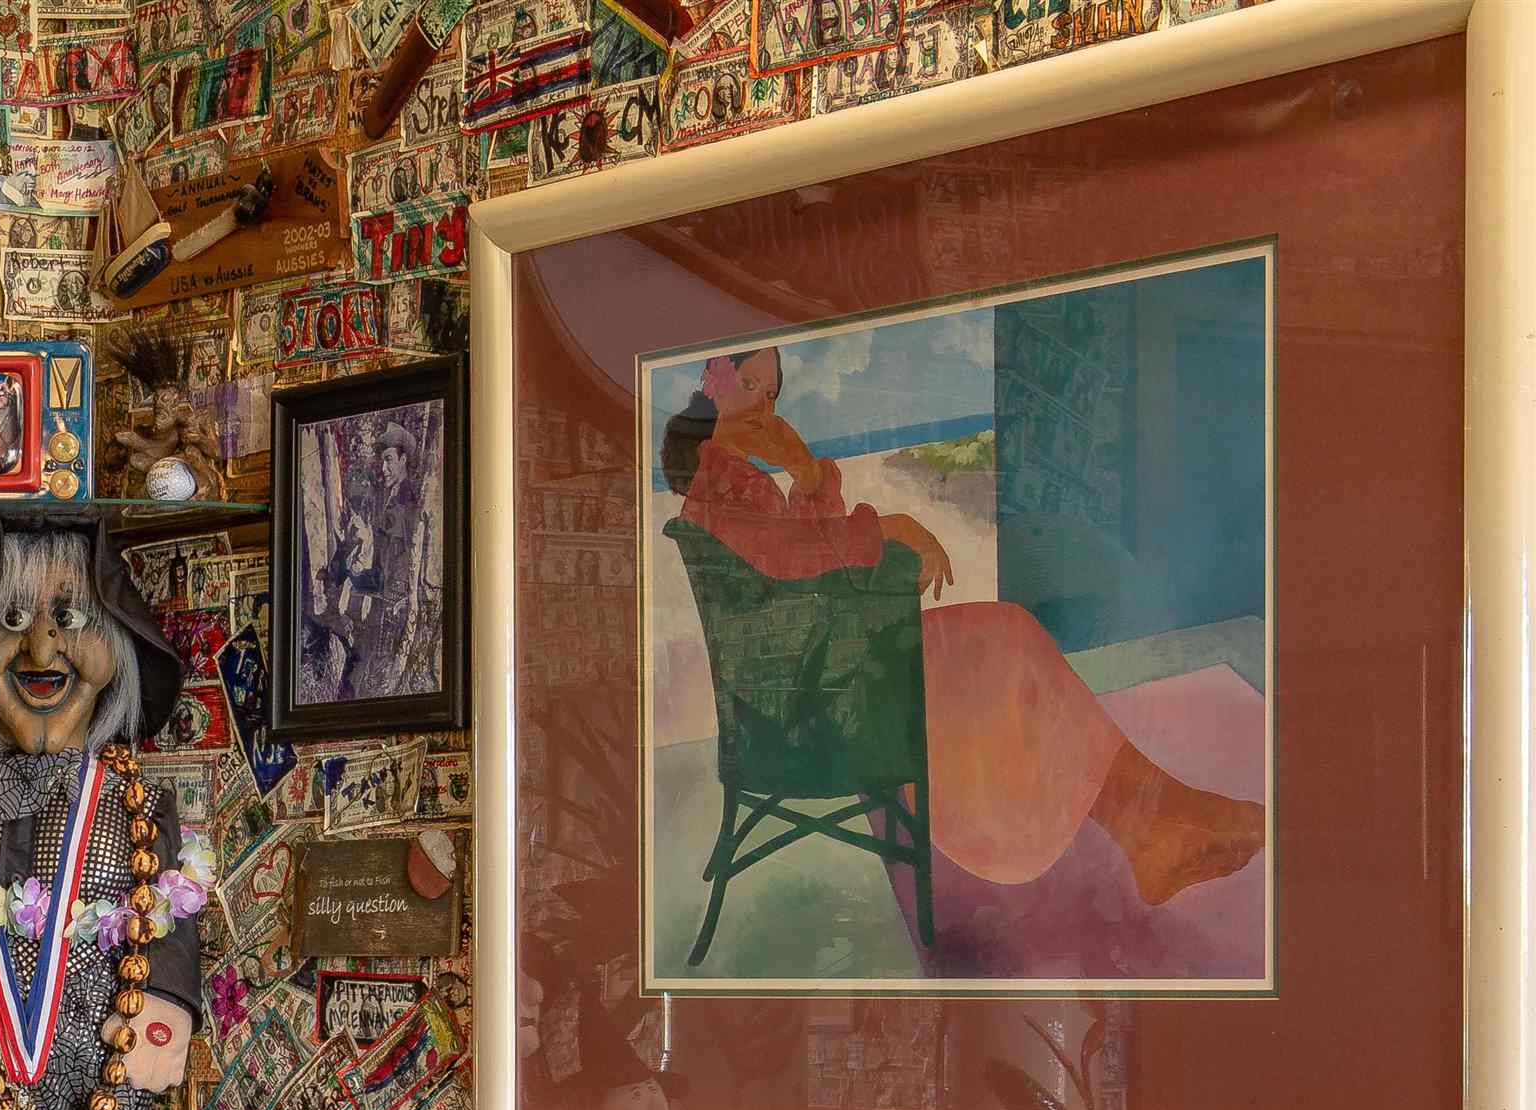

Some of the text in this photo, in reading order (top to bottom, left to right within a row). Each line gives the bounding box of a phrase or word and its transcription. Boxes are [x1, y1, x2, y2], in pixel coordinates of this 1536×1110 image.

[275, 250, 326, 275] AUSSIES
[170, 276, 197, 295] USA
[308, 892, 409, 925] silly question
